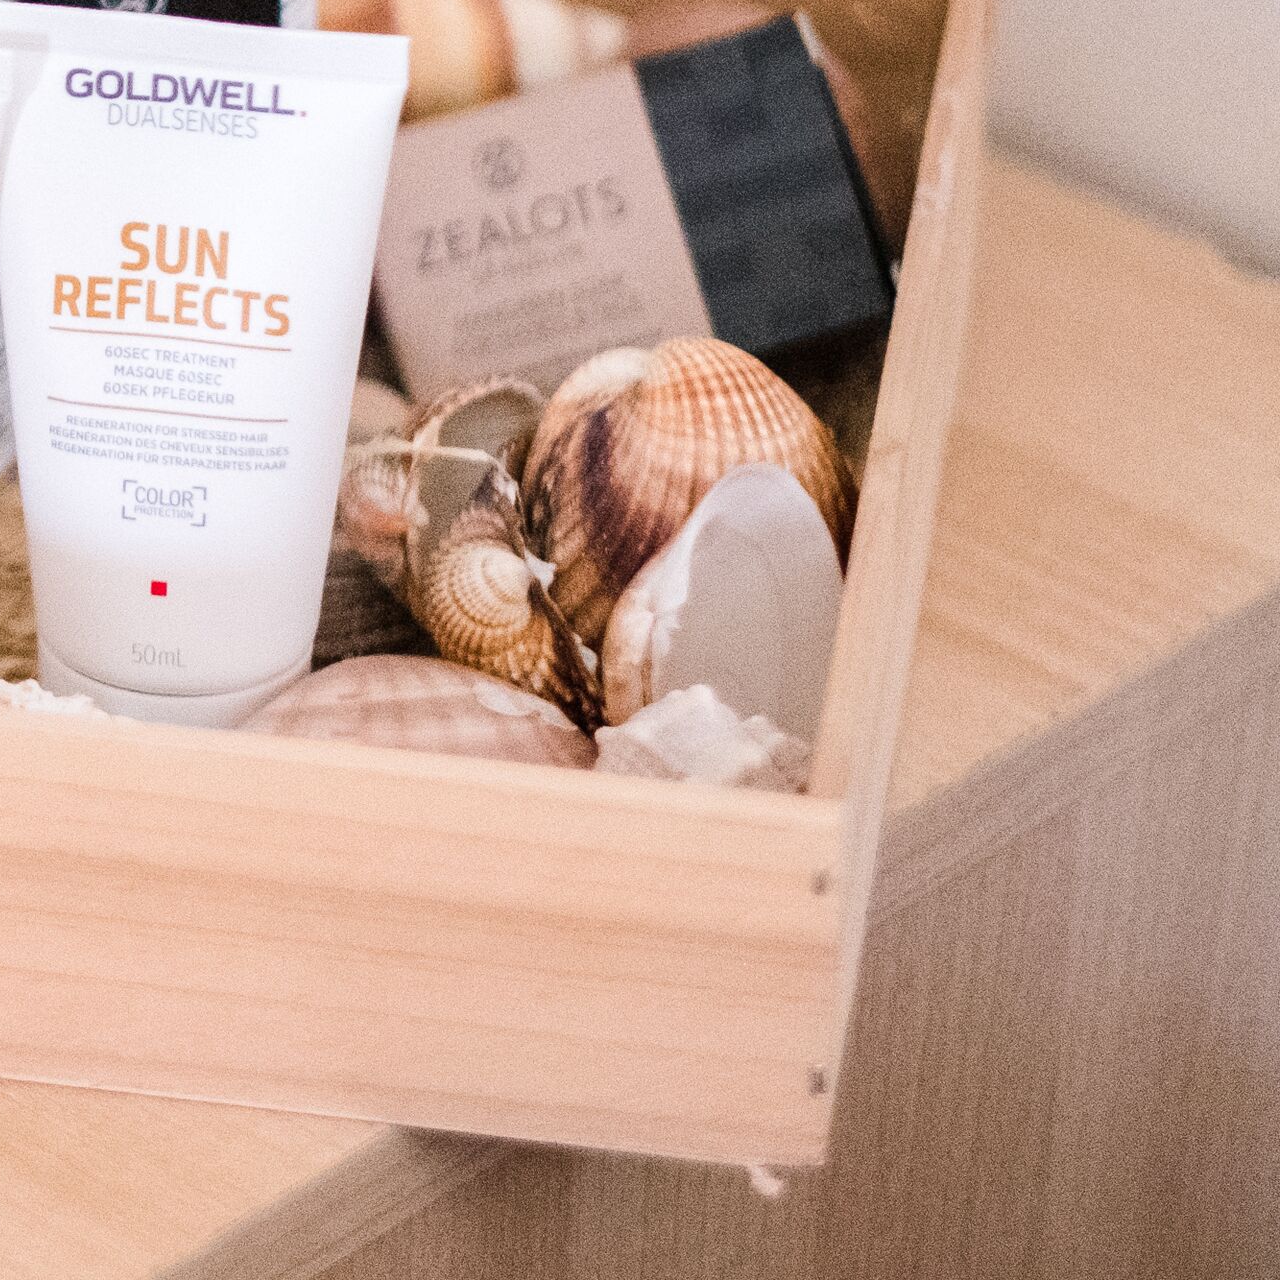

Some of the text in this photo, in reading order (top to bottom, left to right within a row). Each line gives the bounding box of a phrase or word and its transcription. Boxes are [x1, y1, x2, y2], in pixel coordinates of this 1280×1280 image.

[107, 102, 260, 139] DUALSENSES
[410, 176, 632, 277] ZEALOTS
[119, 221, 229, 280] SUN
[53, 274, 290, 337] REFLECTS
[105, 346, 237, 369] 60SEC TREATMENT
[114, 365, 222, 386] MASQUE 60SEC
[103, 382, 235, 405] 60SEK PFLEGEKUR
[67, 415, 268, 442] REGENERATION FOR STRESSED HAIR
[51, 439, 133, 462] REGENERATION
[162, 455, 252, 471] STRAPAZIERTES
[255, 460, 286, 471] HAAR
[135, 438, 157, 449] DES
[160, 440, 212, 455] CHEVEUX
[135, 486, 194, 508] COLOR
[134, 505, 194, 520] PROTECTION
[131, 641, 186, 669] 50mL
